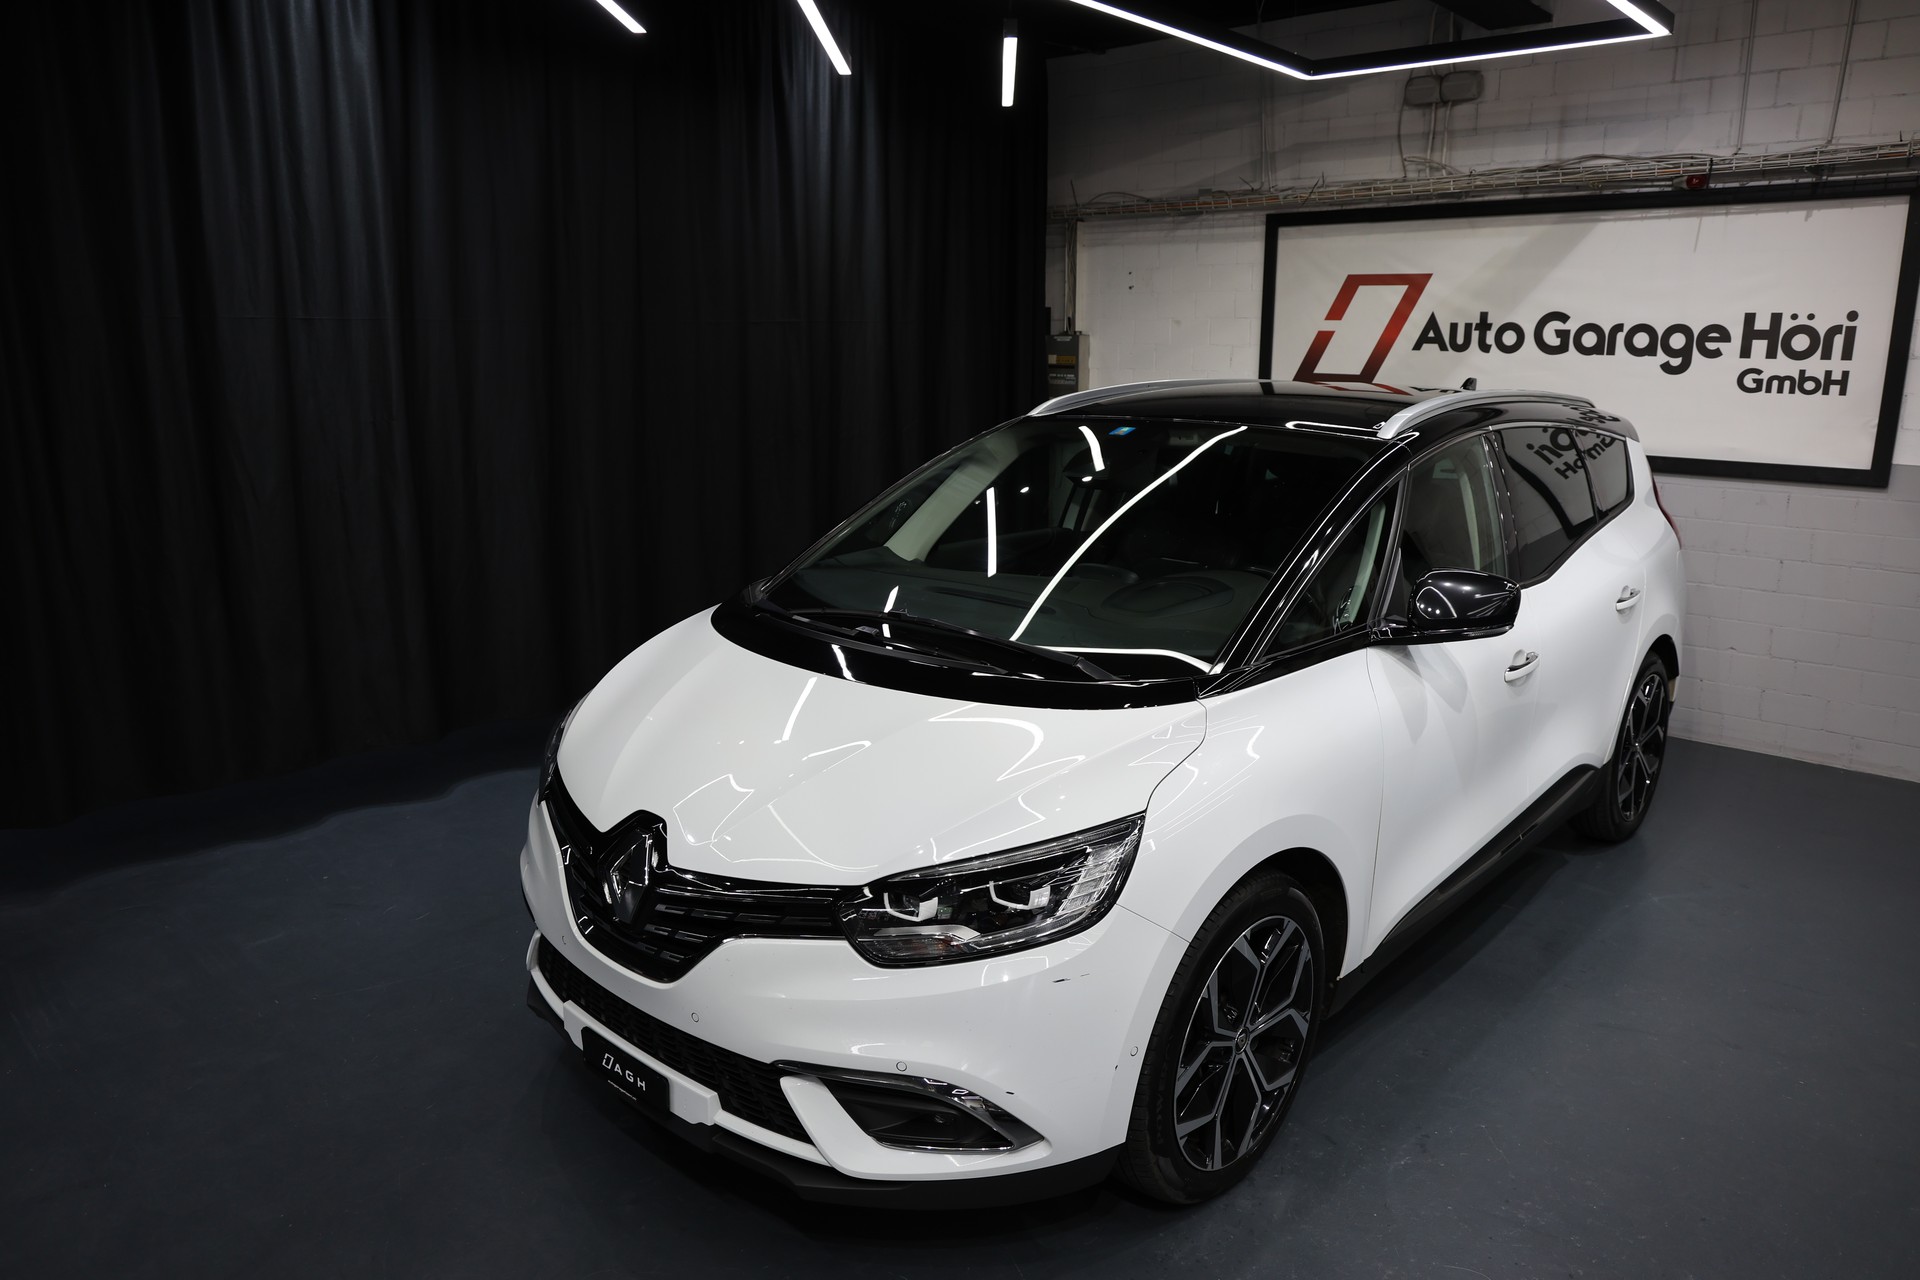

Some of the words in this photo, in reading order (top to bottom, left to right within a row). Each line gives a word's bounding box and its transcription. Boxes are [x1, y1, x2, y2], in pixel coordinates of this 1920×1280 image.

[1412, 311, 1525, 354] Auto
[1534, 311, 1732, 376] Garage
[1739, 310, 1859, 361] Höri
[1736, 367, 1850, 396] GmbH
[614, 1063, 646, 1092] AGH
